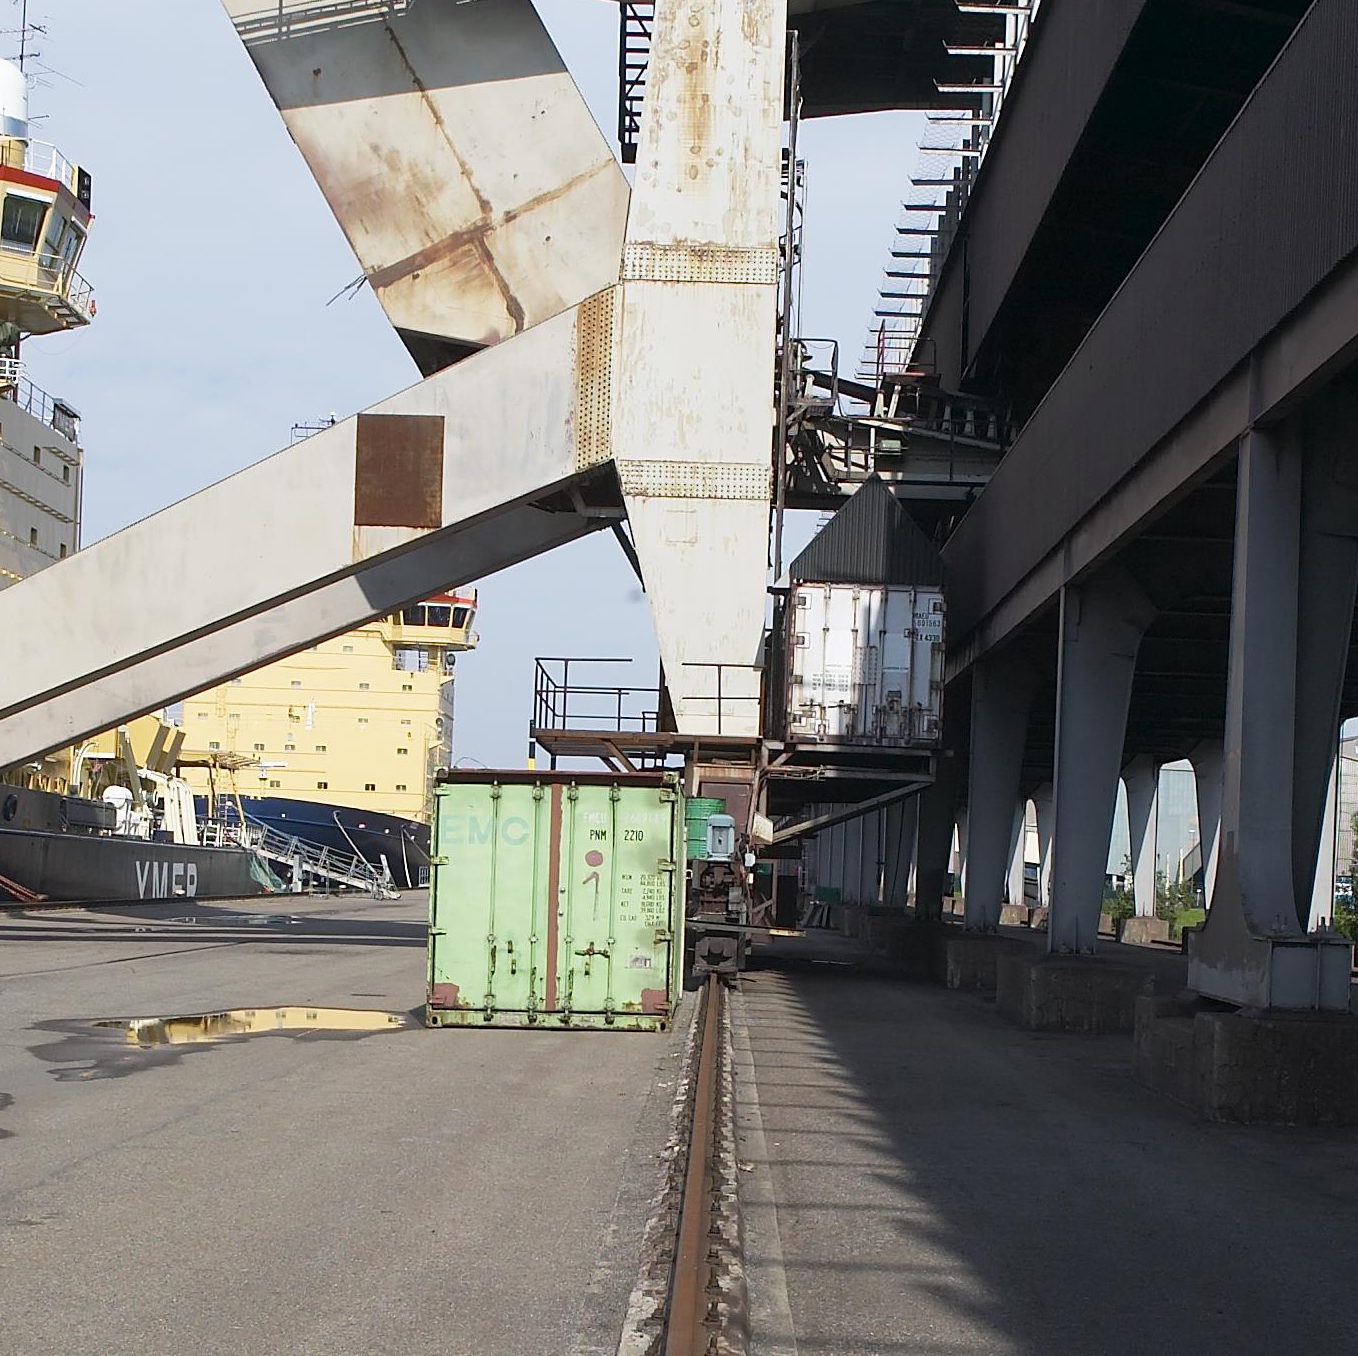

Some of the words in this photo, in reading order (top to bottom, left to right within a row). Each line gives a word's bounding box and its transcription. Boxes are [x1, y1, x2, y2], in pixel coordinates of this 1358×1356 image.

[440, 814, 531, 846] EMC
[589, 829, 607, 841] PNM
[624, 829, 644, 842] 2210
